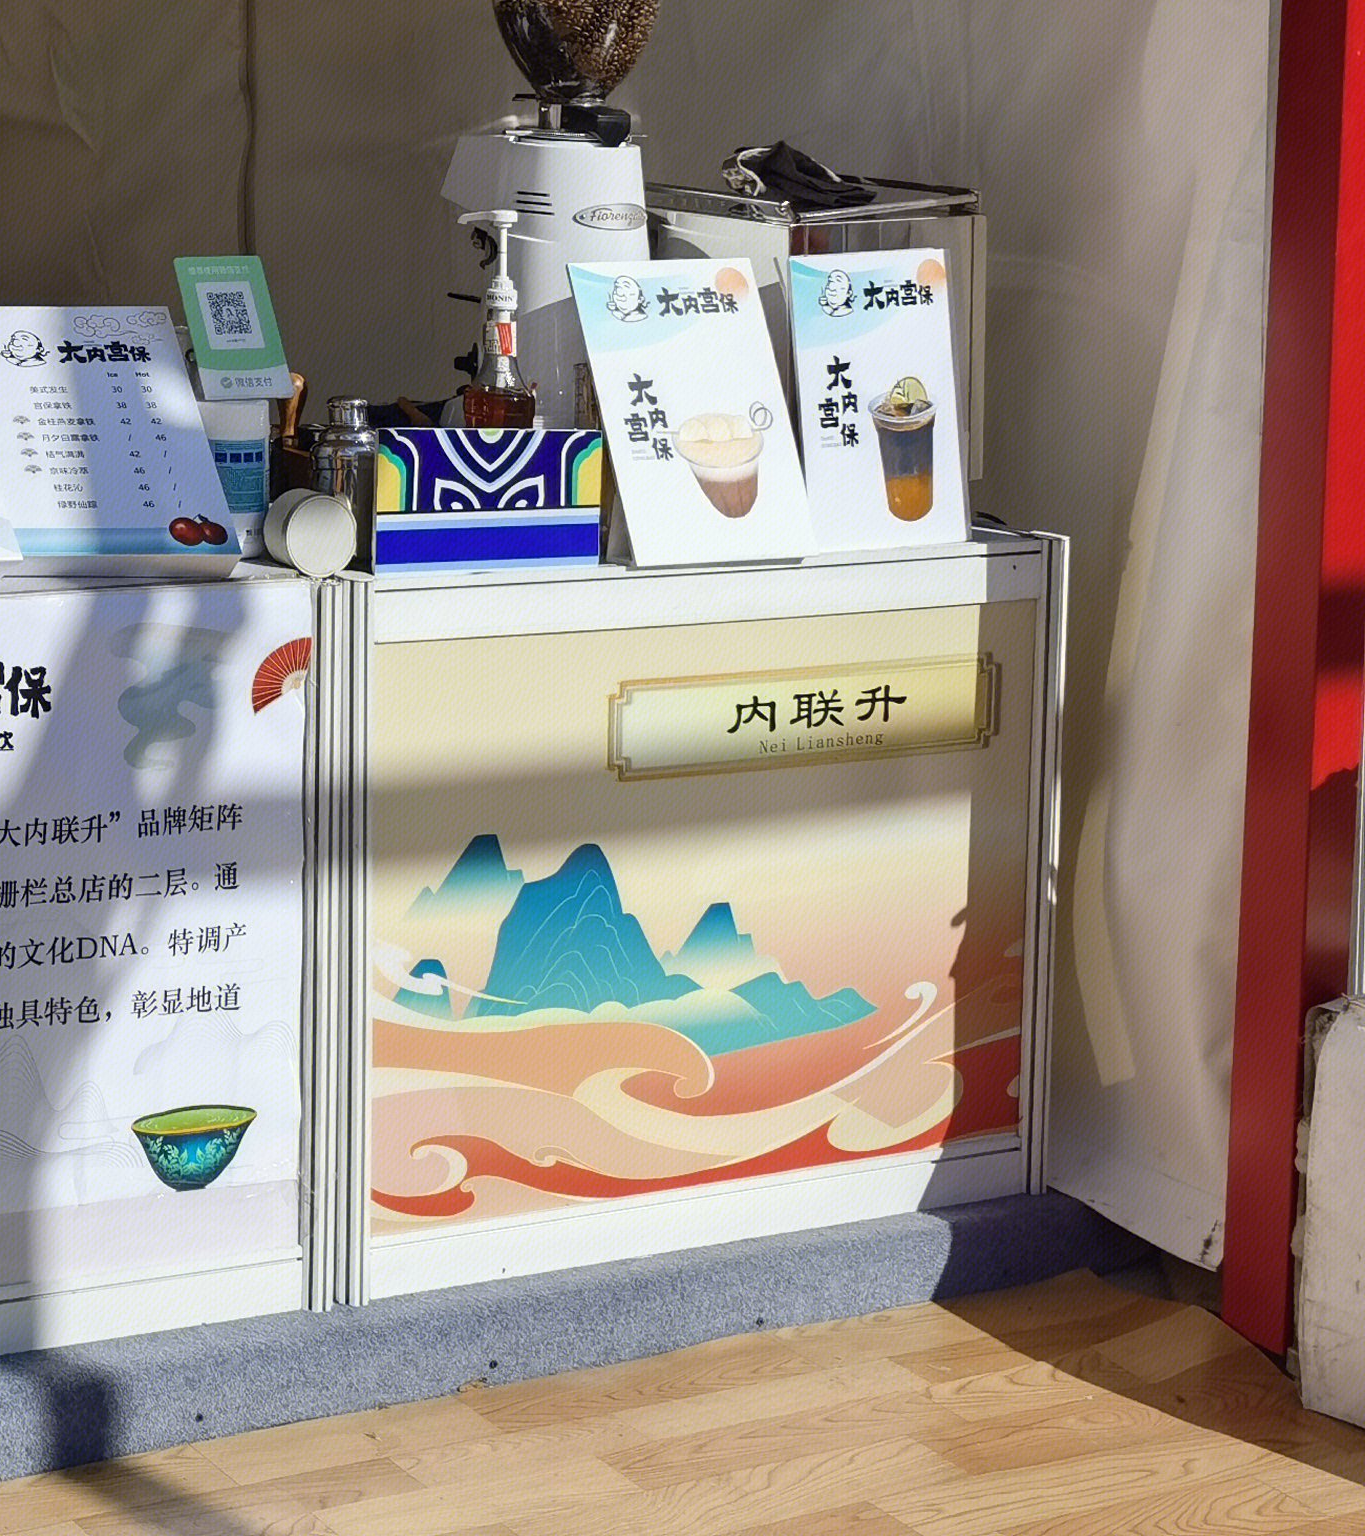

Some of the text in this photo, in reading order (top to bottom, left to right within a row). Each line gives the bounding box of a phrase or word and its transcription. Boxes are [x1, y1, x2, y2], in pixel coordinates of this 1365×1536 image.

[589, 207, 646, 226] Fiorenza
[862, 279, 934, 311] 大内宫保
[655, 286, 739, 317] 大内宫保
[56, 340, 152, 364] 大内宫保
[111, 385, 123, 394] 30
[141, 385, 152, 394] 30
[116, 402, 127, 410] 38
[146, 402, 157, 410] 38
[120, 418, 132, 426] 42
[150, 418, 162, 426] 42
[155, 434, 167, 442] 46
[129, 450, 141, 458] 42
[133, 467, 145, 475] 46
[138, 484, 150, 492] 46
[726, 684, 908, 734] 内联升
[759, 731, 885, 755] Nei Liansheng
